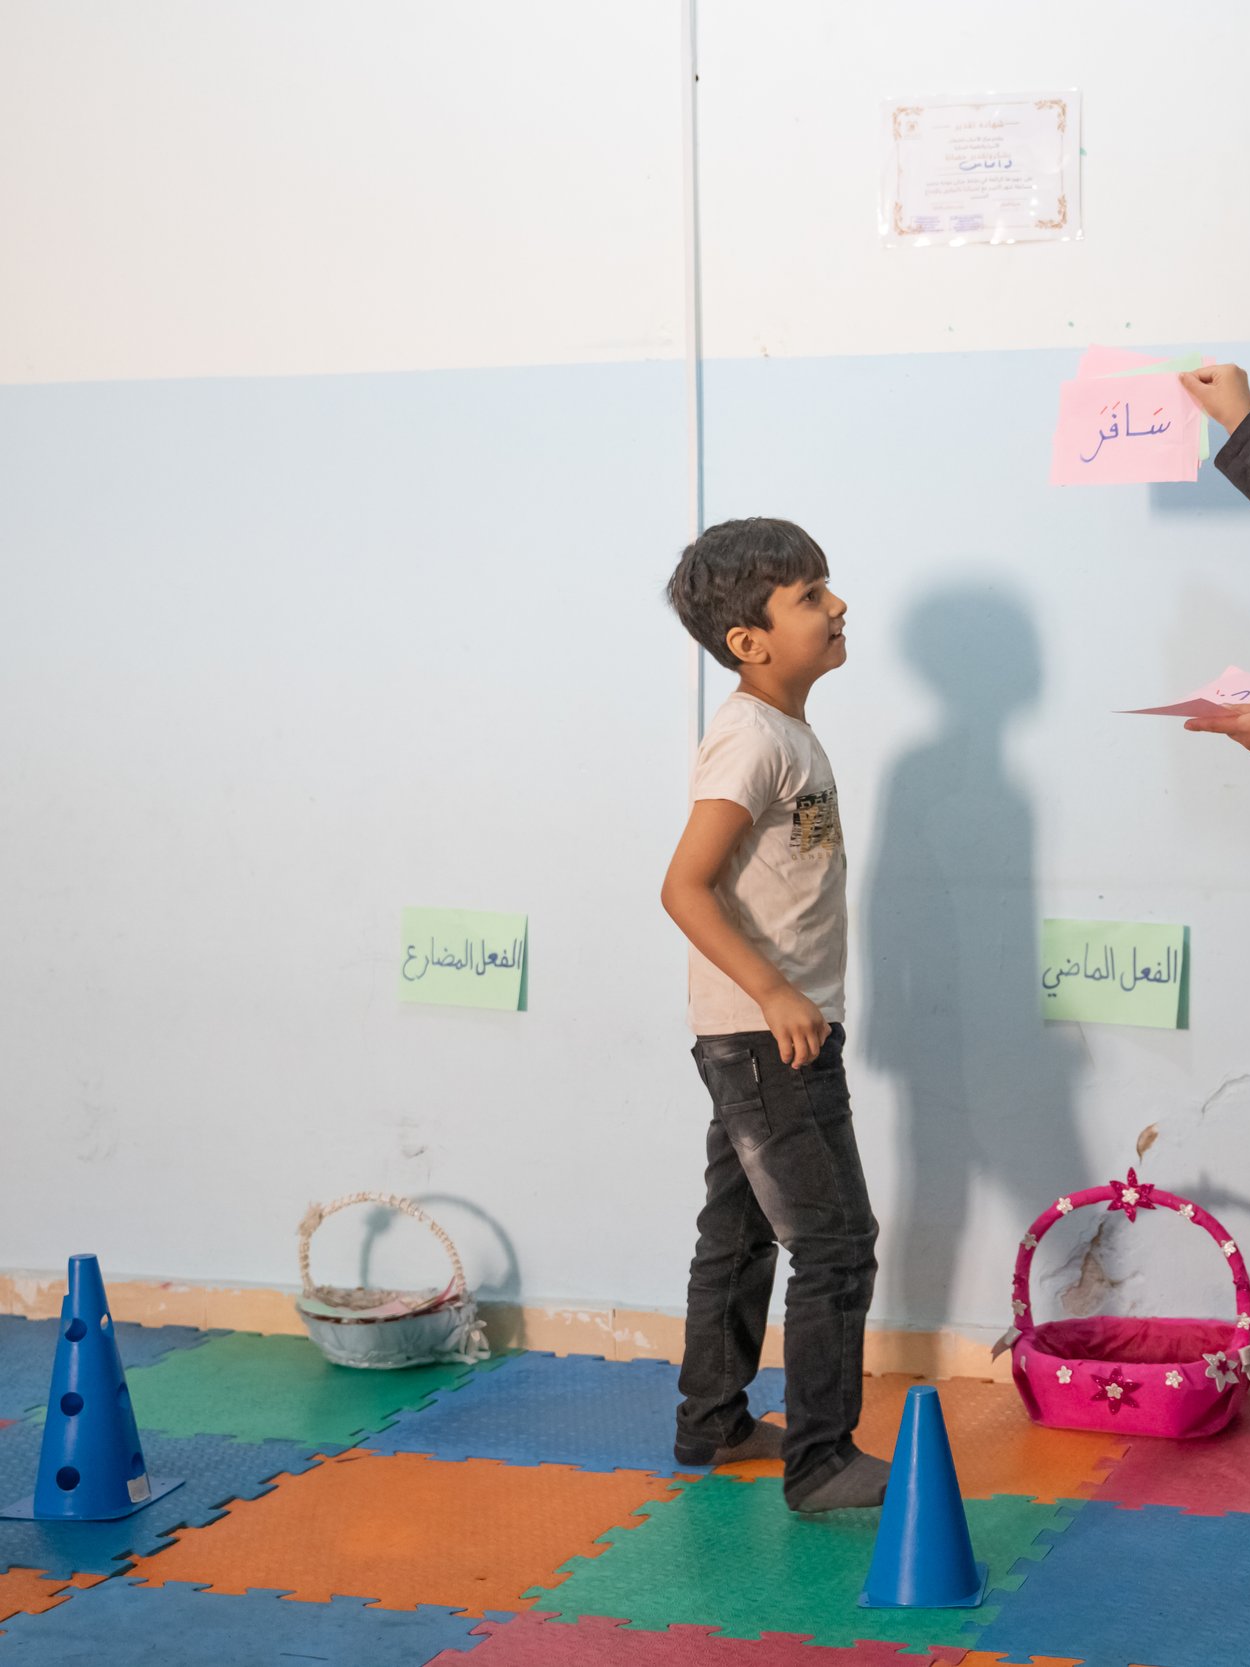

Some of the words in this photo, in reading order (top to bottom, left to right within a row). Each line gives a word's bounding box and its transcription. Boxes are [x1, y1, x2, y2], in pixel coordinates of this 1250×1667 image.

[402, 936, 474, 982] المضارع
[475, 937, 523, 976] الفعل
[1041, 942, 1116, 998] الماضي
[1120, 945, 1178, 992] الفعل
